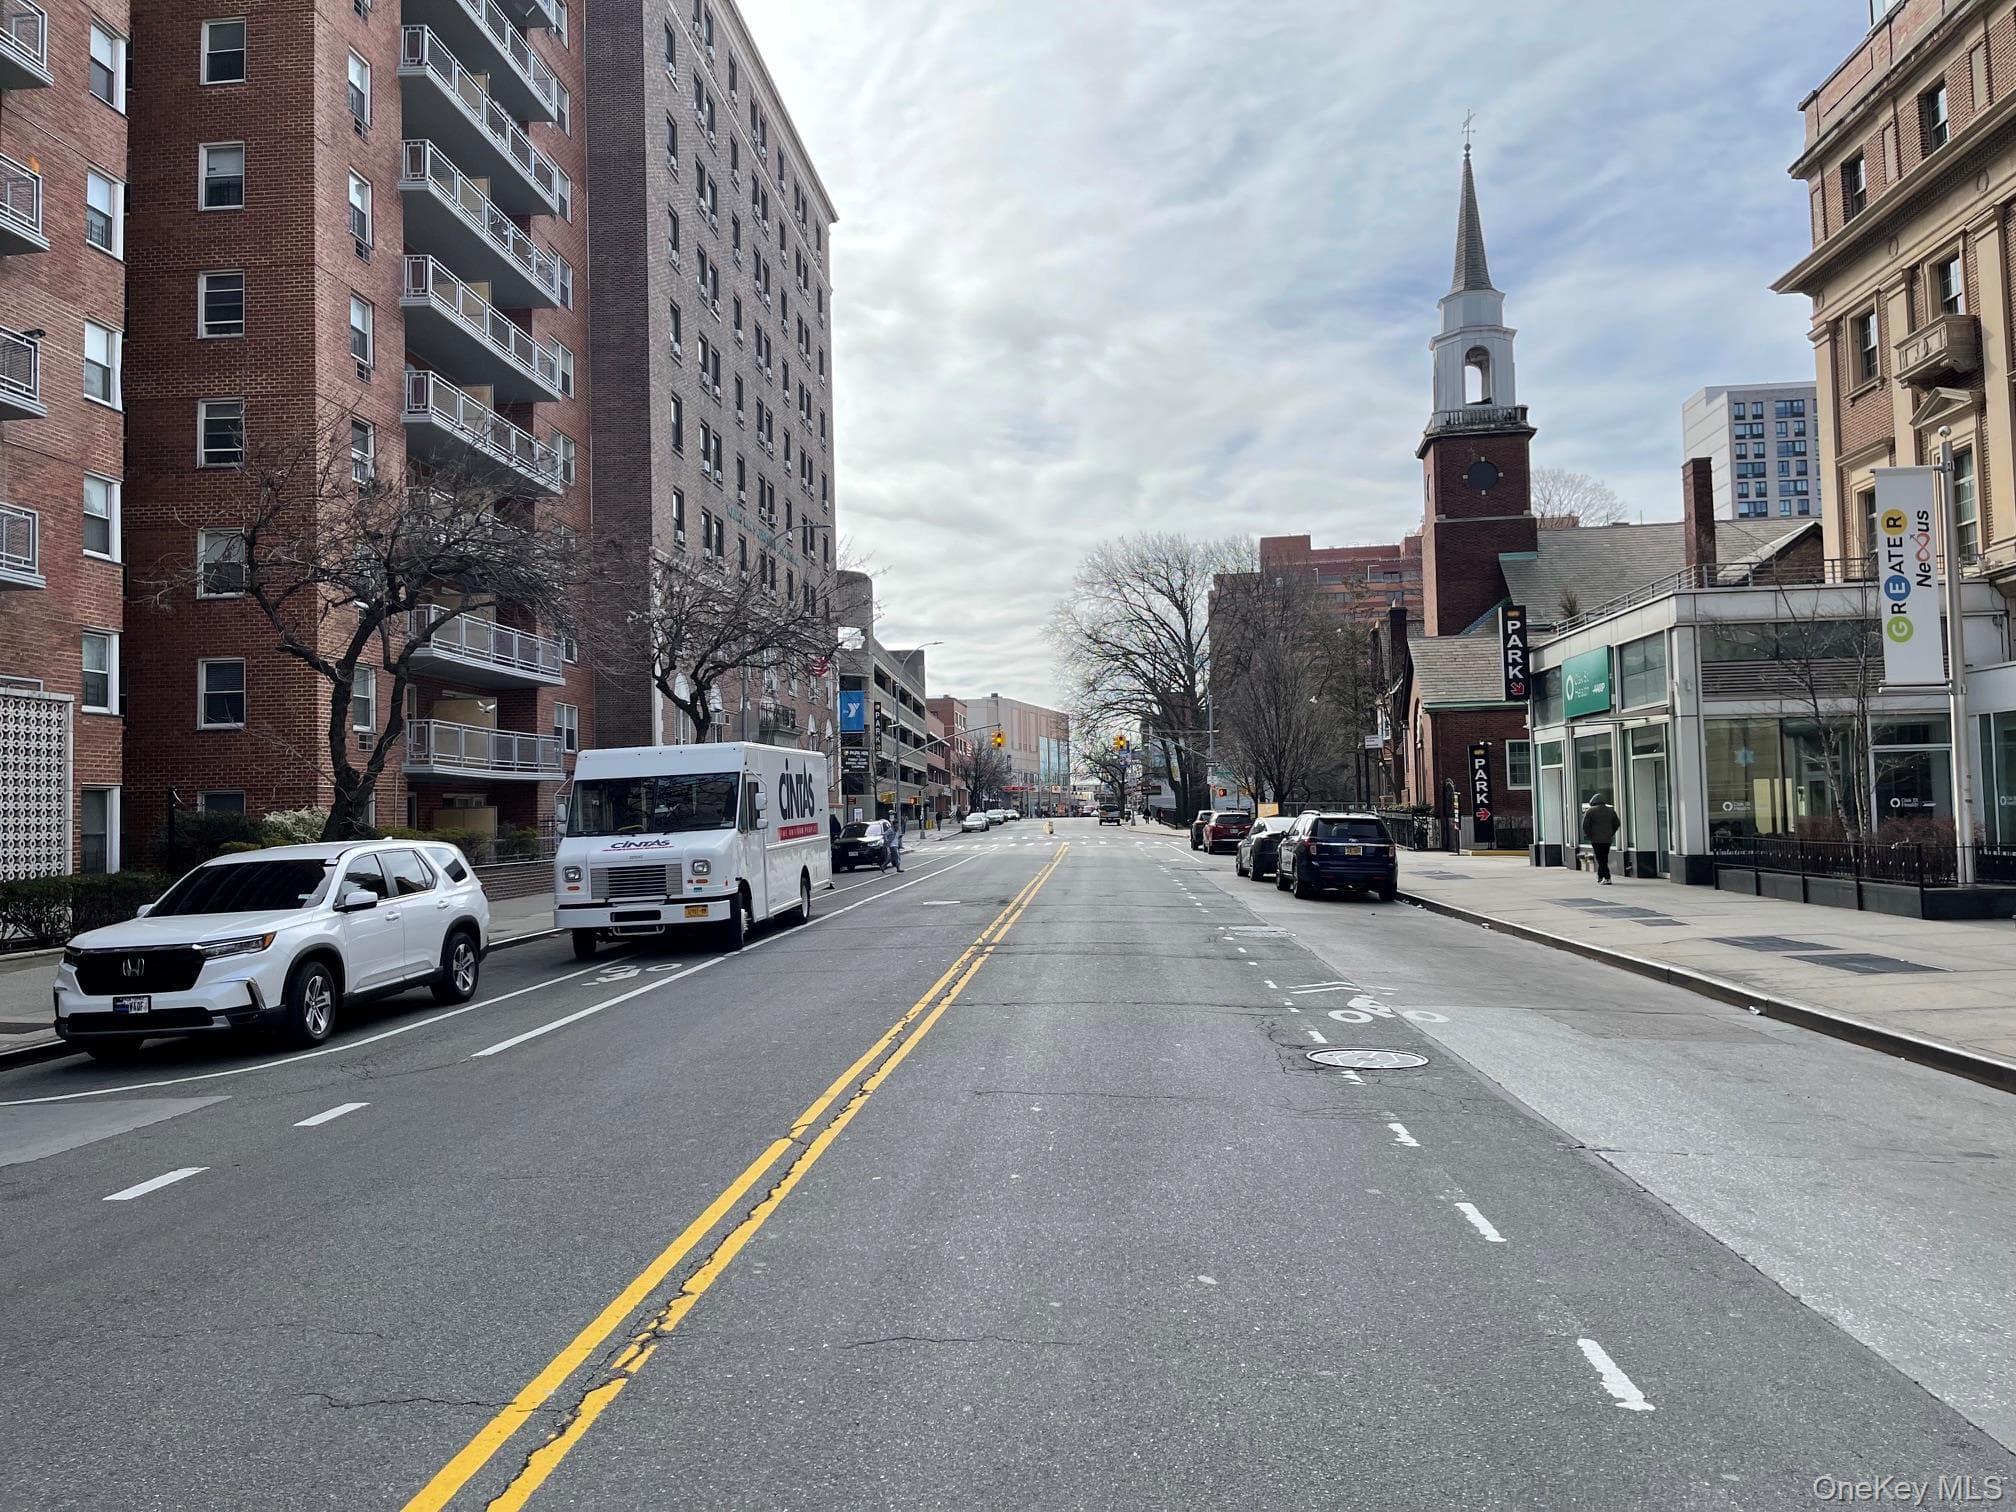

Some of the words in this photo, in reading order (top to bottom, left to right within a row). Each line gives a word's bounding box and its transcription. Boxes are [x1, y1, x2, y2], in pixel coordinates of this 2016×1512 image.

[1886, 515, 1909, 638] GREATER
[1507, 620, 1524, 679] PARK
[1474, 758, 1489, 804] PARK
